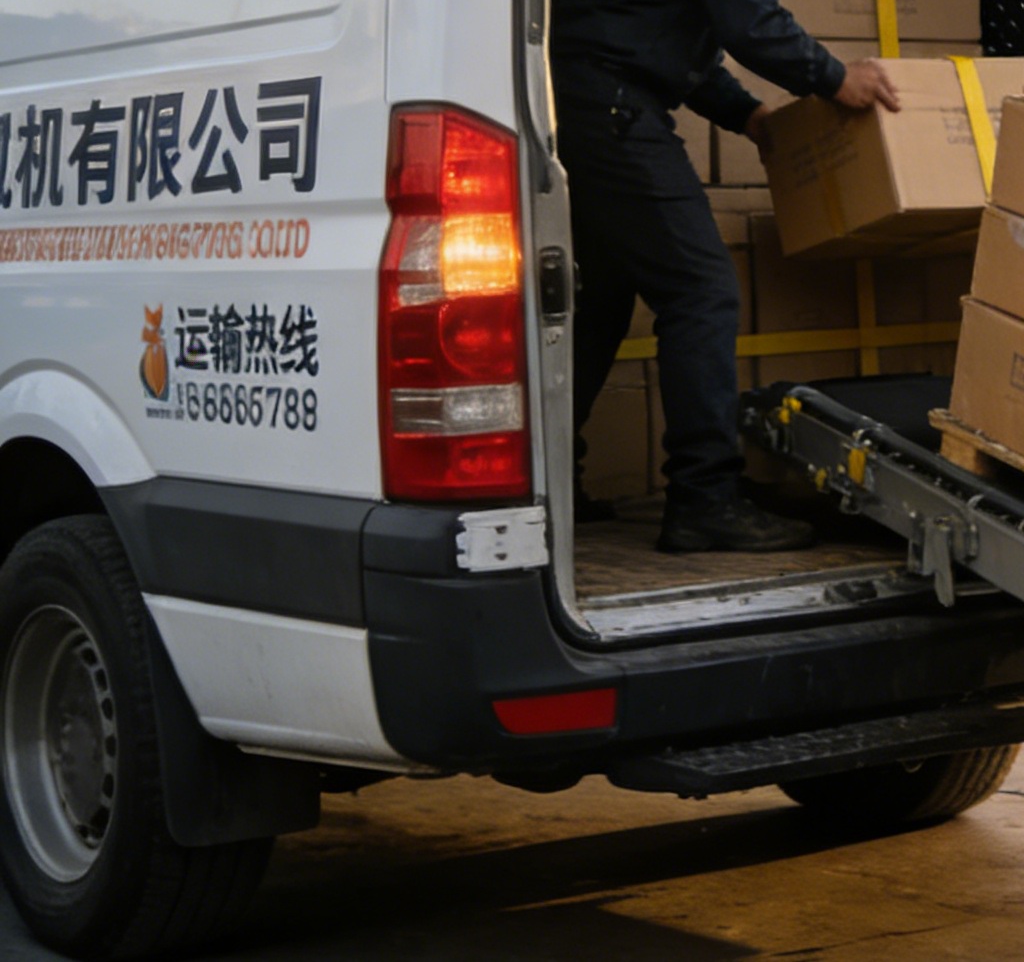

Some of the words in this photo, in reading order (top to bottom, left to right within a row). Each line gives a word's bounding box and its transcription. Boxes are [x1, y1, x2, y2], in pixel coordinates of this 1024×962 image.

[0, 76, 322, 209] 机有限公司
[174, 303, 319, 377] 运输热线
